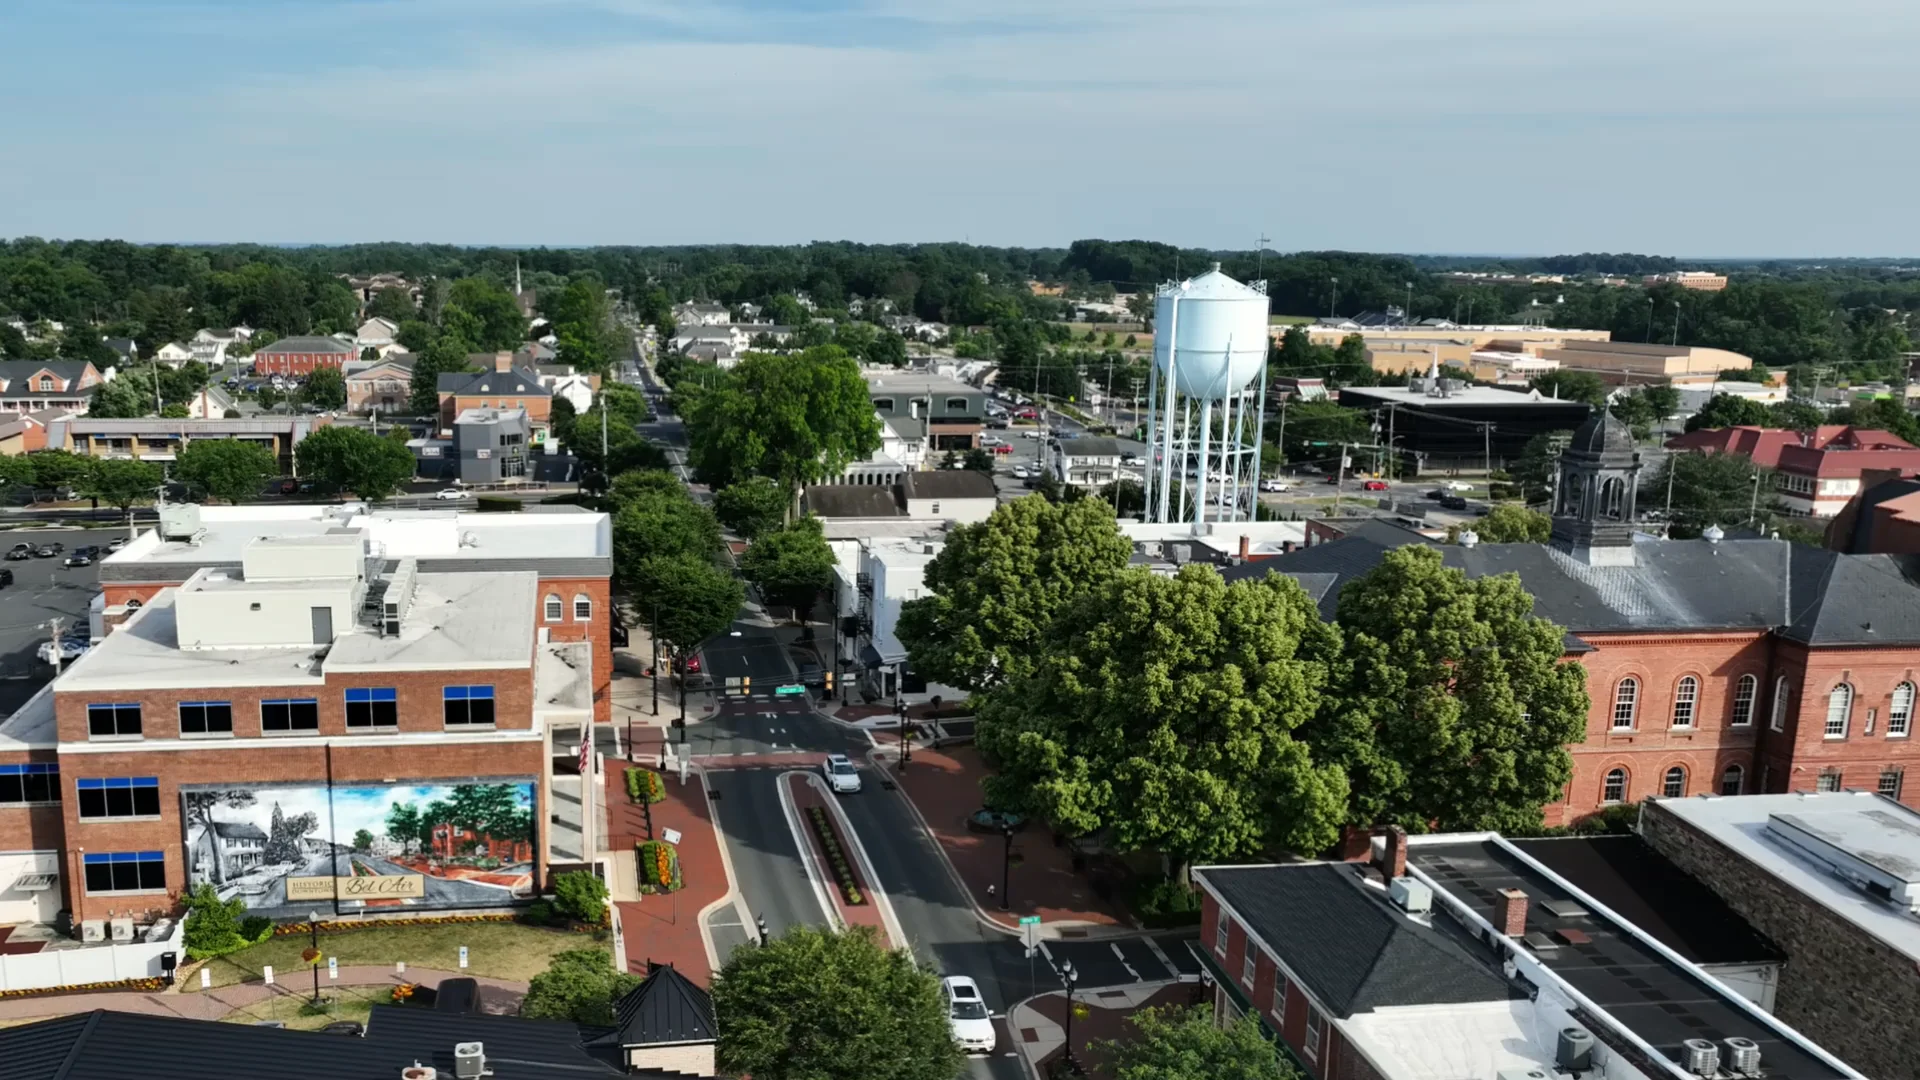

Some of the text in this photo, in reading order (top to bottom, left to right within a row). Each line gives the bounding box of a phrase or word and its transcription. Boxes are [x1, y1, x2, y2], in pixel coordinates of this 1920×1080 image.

[292, 880, 334, 888] HISTORIC
[345, 876, 417, 896] Bel Air
